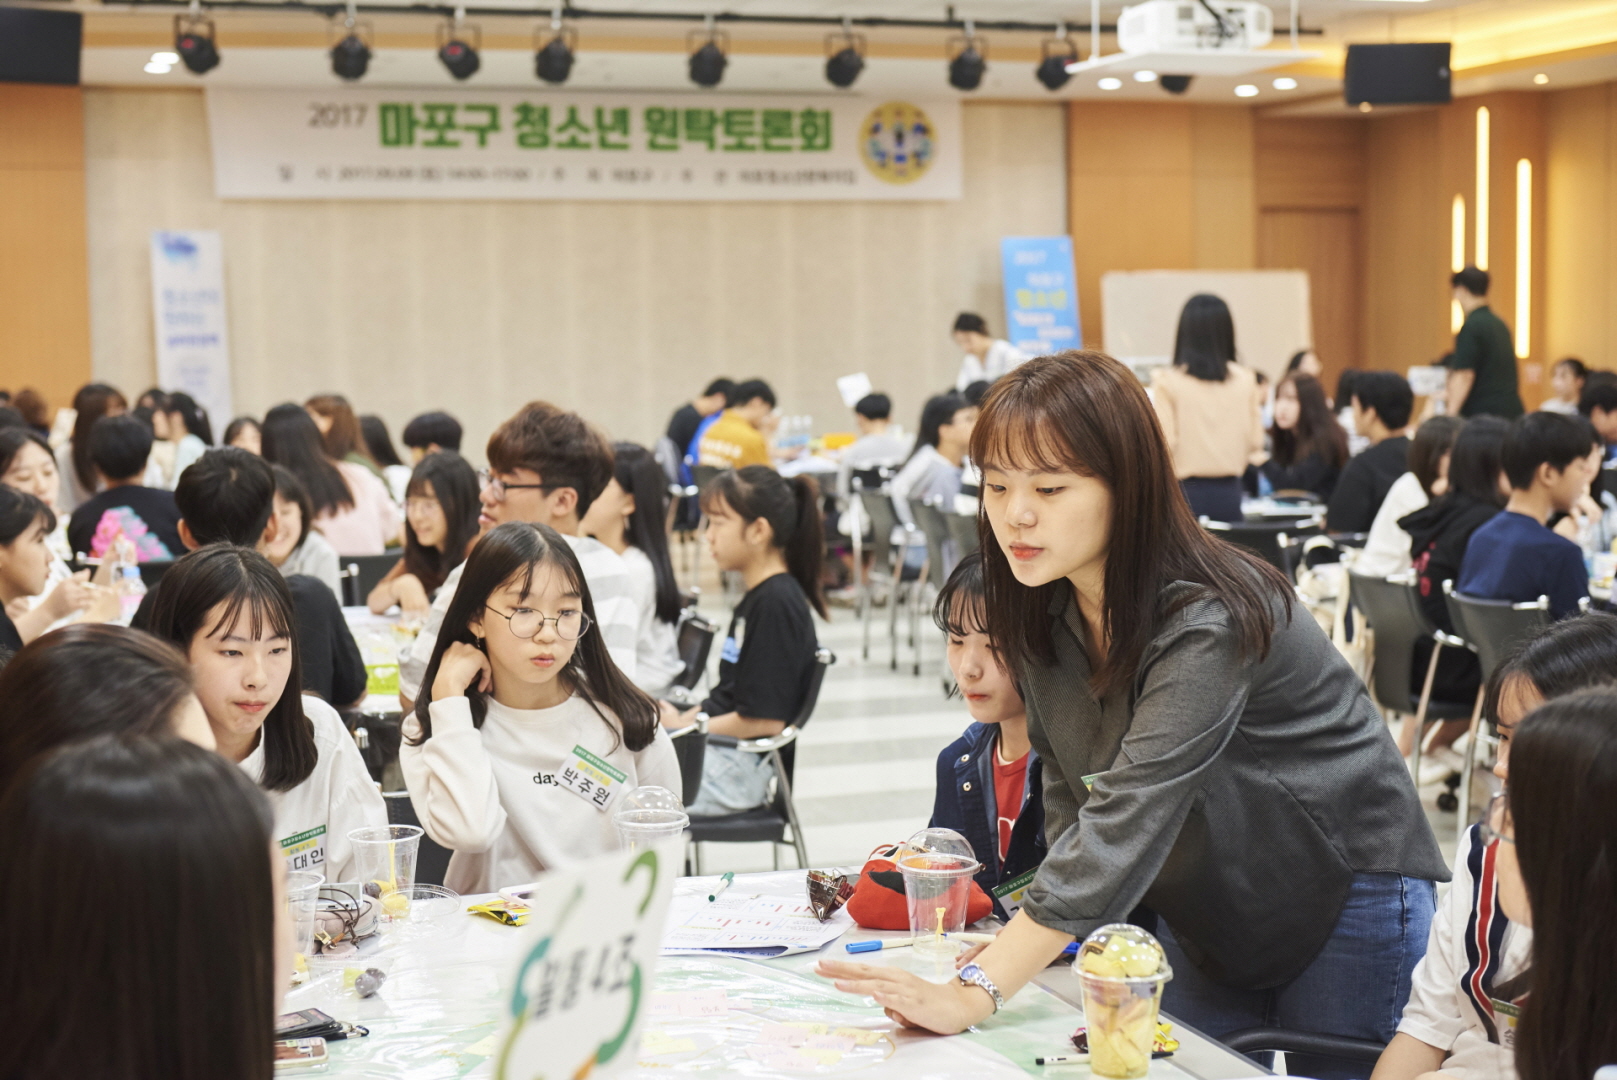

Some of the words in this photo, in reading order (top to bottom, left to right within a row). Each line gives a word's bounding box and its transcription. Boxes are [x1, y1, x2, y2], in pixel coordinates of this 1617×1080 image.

[306, 104, 368, 128] 2017
[379, 103, 501, 148] 마포구
[514, 102, 630, 150] 청소년
[644, 106, 832, 152] 원탁토론회
[562, 767, 610, 806] 박주원
